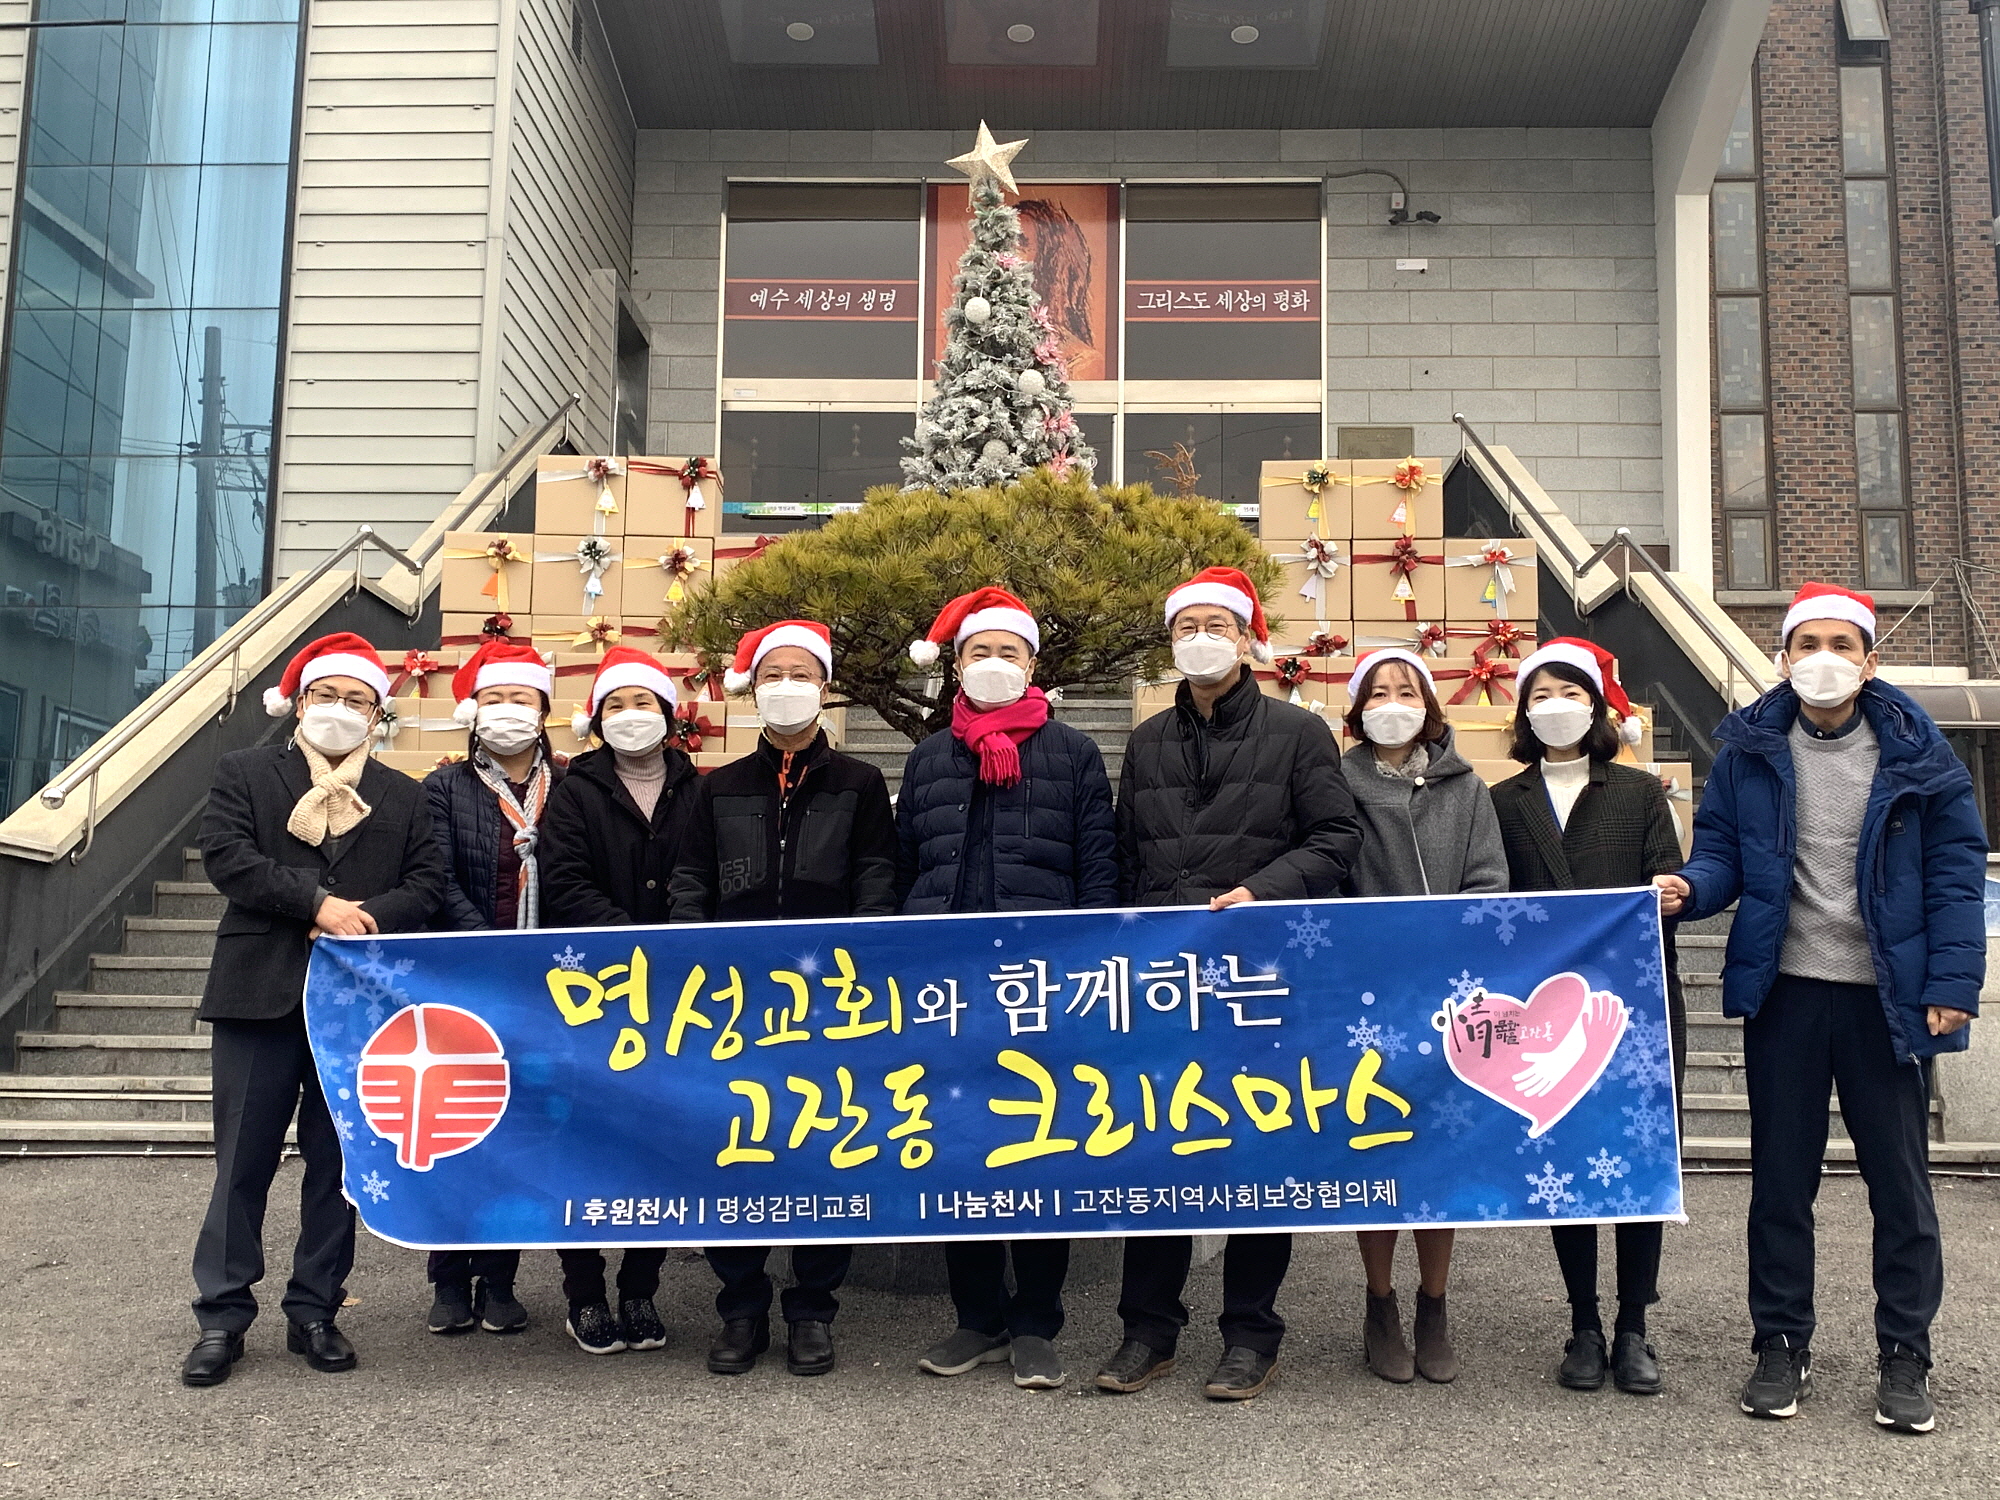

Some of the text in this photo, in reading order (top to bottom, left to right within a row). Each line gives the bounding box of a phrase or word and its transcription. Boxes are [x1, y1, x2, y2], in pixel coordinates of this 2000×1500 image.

[749, 287, 897, 312] 예수 세상의 생명
[1136, 289, 1311, 313] 그리스도 세상의 평화
[545, 945, 1290, 1072] 명성교회와 함께하는
[1519, 1021, 1555, 1043] 고잔동
[715, 1048, 1414, 1170] 고잔동 크리스마스
[581, 1193, 872, 1225] 후원천사 명성감리교회
[937, 1178, 1398, 1219] 나눔천사 고잔동지역사회보장협의체
